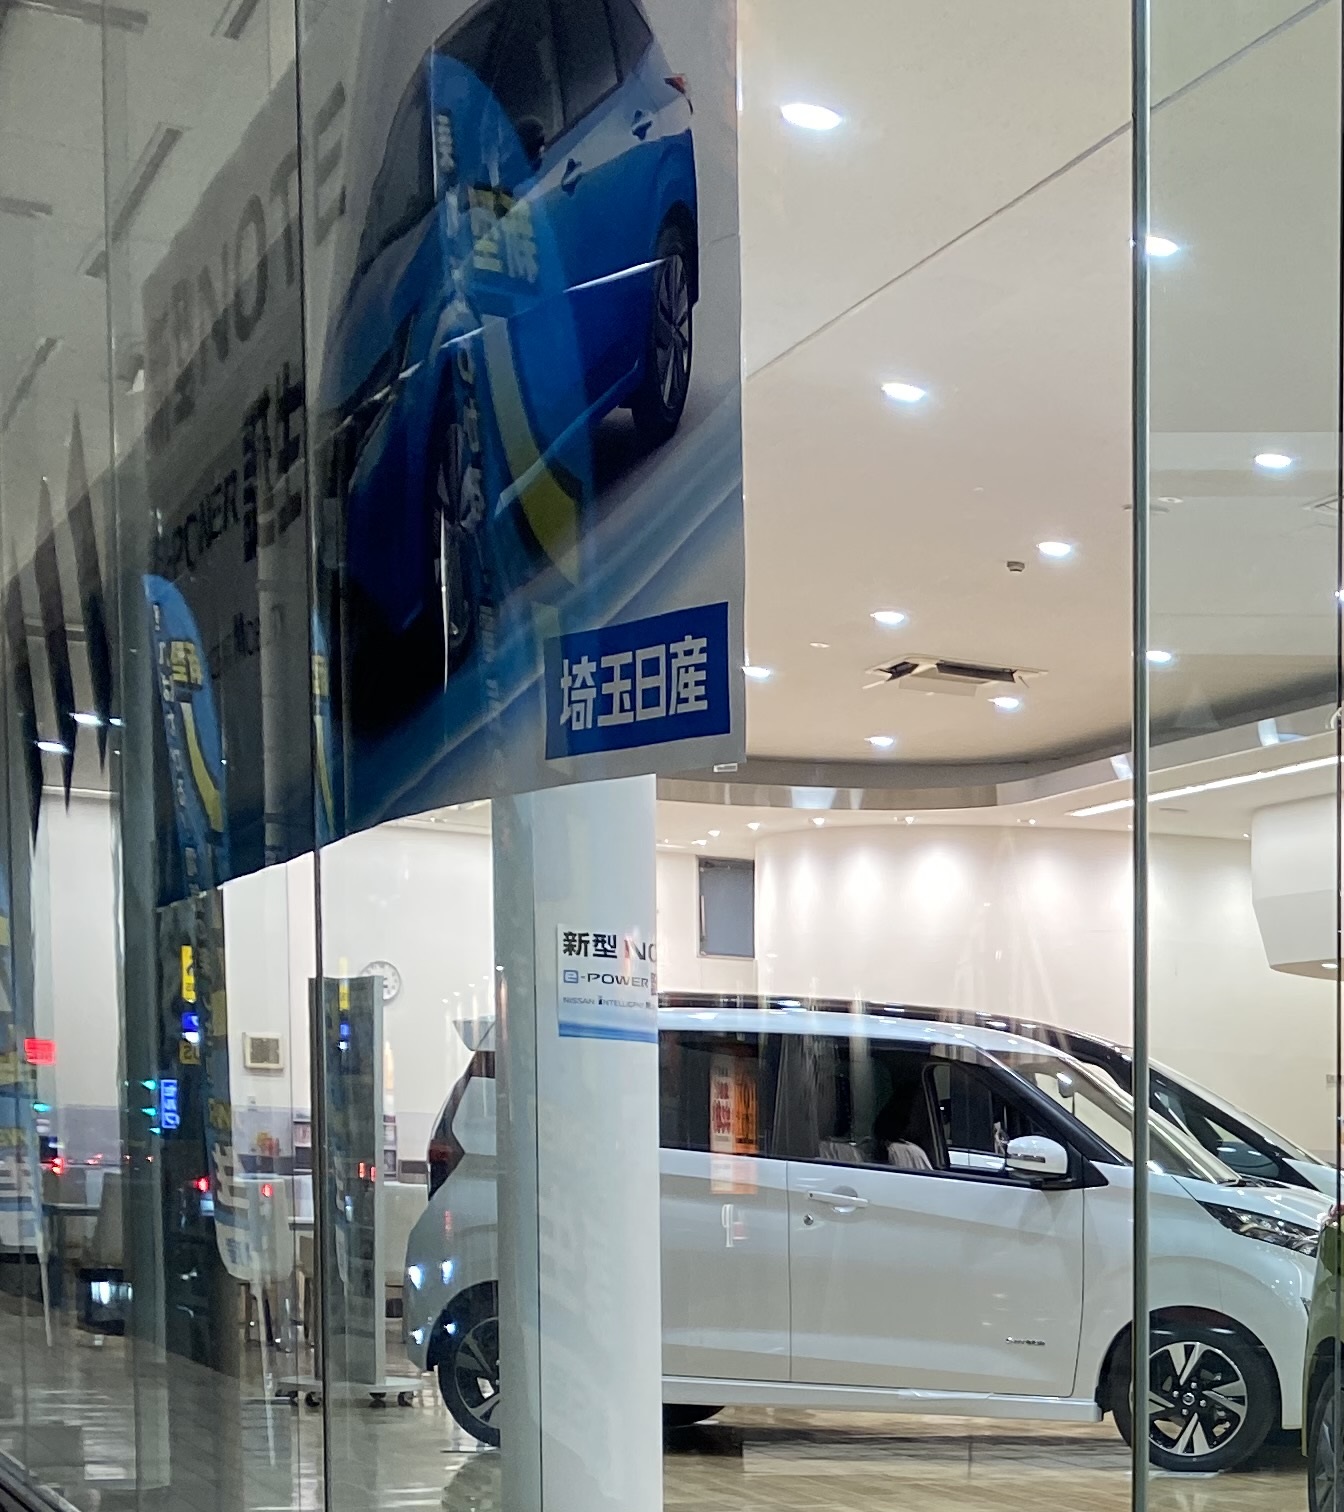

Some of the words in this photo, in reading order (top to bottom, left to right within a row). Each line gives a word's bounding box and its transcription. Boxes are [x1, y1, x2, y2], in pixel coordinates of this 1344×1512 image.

[560, 634, 708, 731] 埼玉日産
[563, 931, 618, 959] 新型
